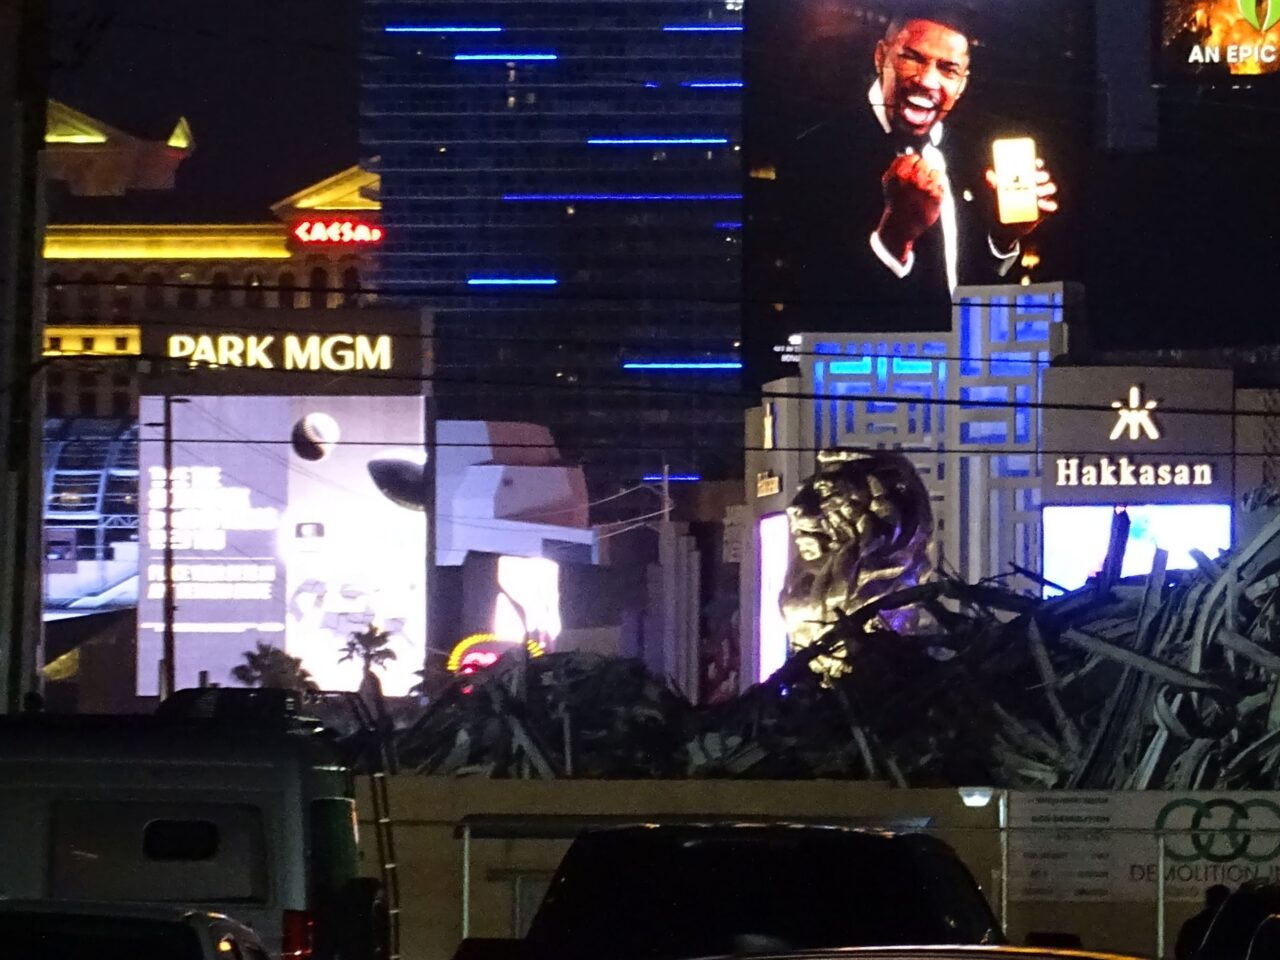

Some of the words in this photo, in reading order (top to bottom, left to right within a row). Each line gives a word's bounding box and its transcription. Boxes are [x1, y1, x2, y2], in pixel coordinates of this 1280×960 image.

[1188, 44, 1219, 63] AN
[1226, 44, 1276, 63] EPIC
[168, 334, 274, 370] PARK
[284, 334, 392, 371] MGM
[1056, 457, 1213, 486] Hakkasan
